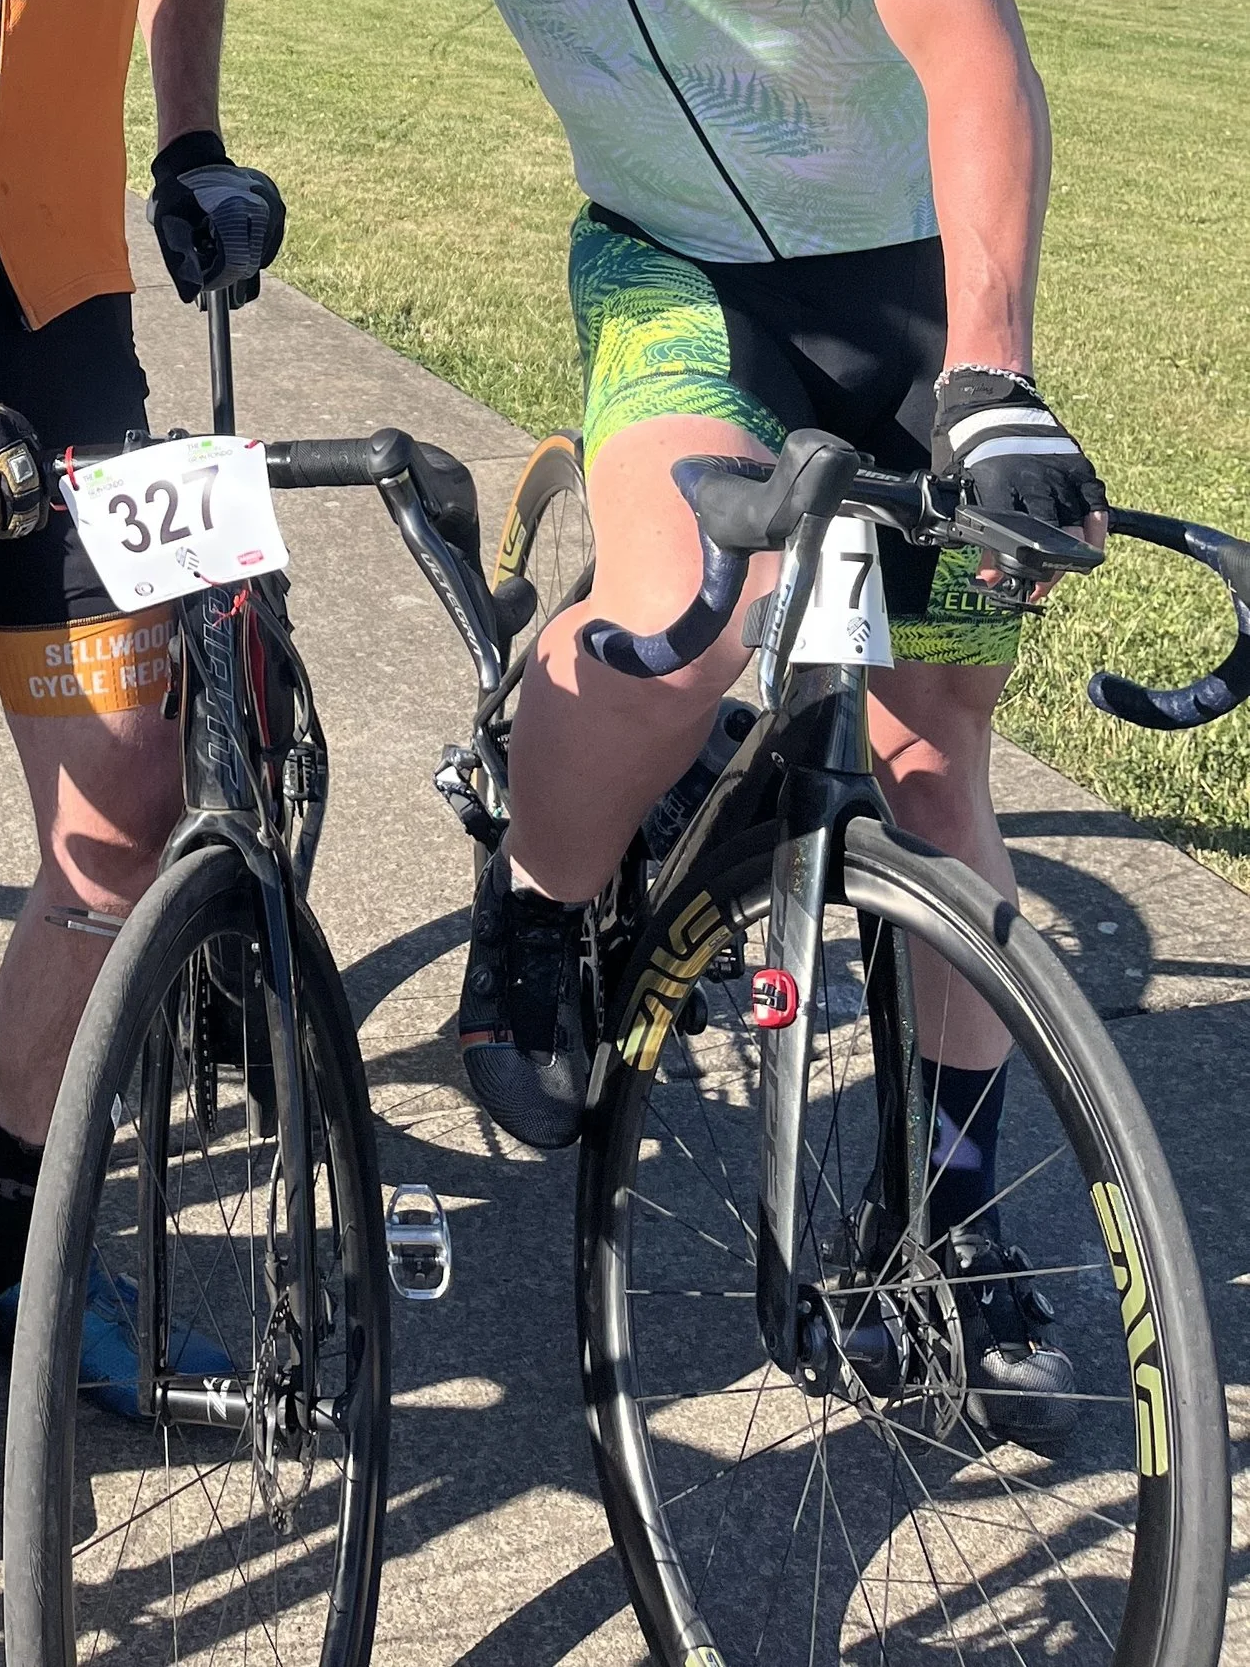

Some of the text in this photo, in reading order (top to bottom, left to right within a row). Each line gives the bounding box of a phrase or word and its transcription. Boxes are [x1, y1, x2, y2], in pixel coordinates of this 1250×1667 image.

[108, 464, 219, 553] 327
[421, 552, 483, 657] ULTEGRA
[28, 669, 110, 699] CYCLE
